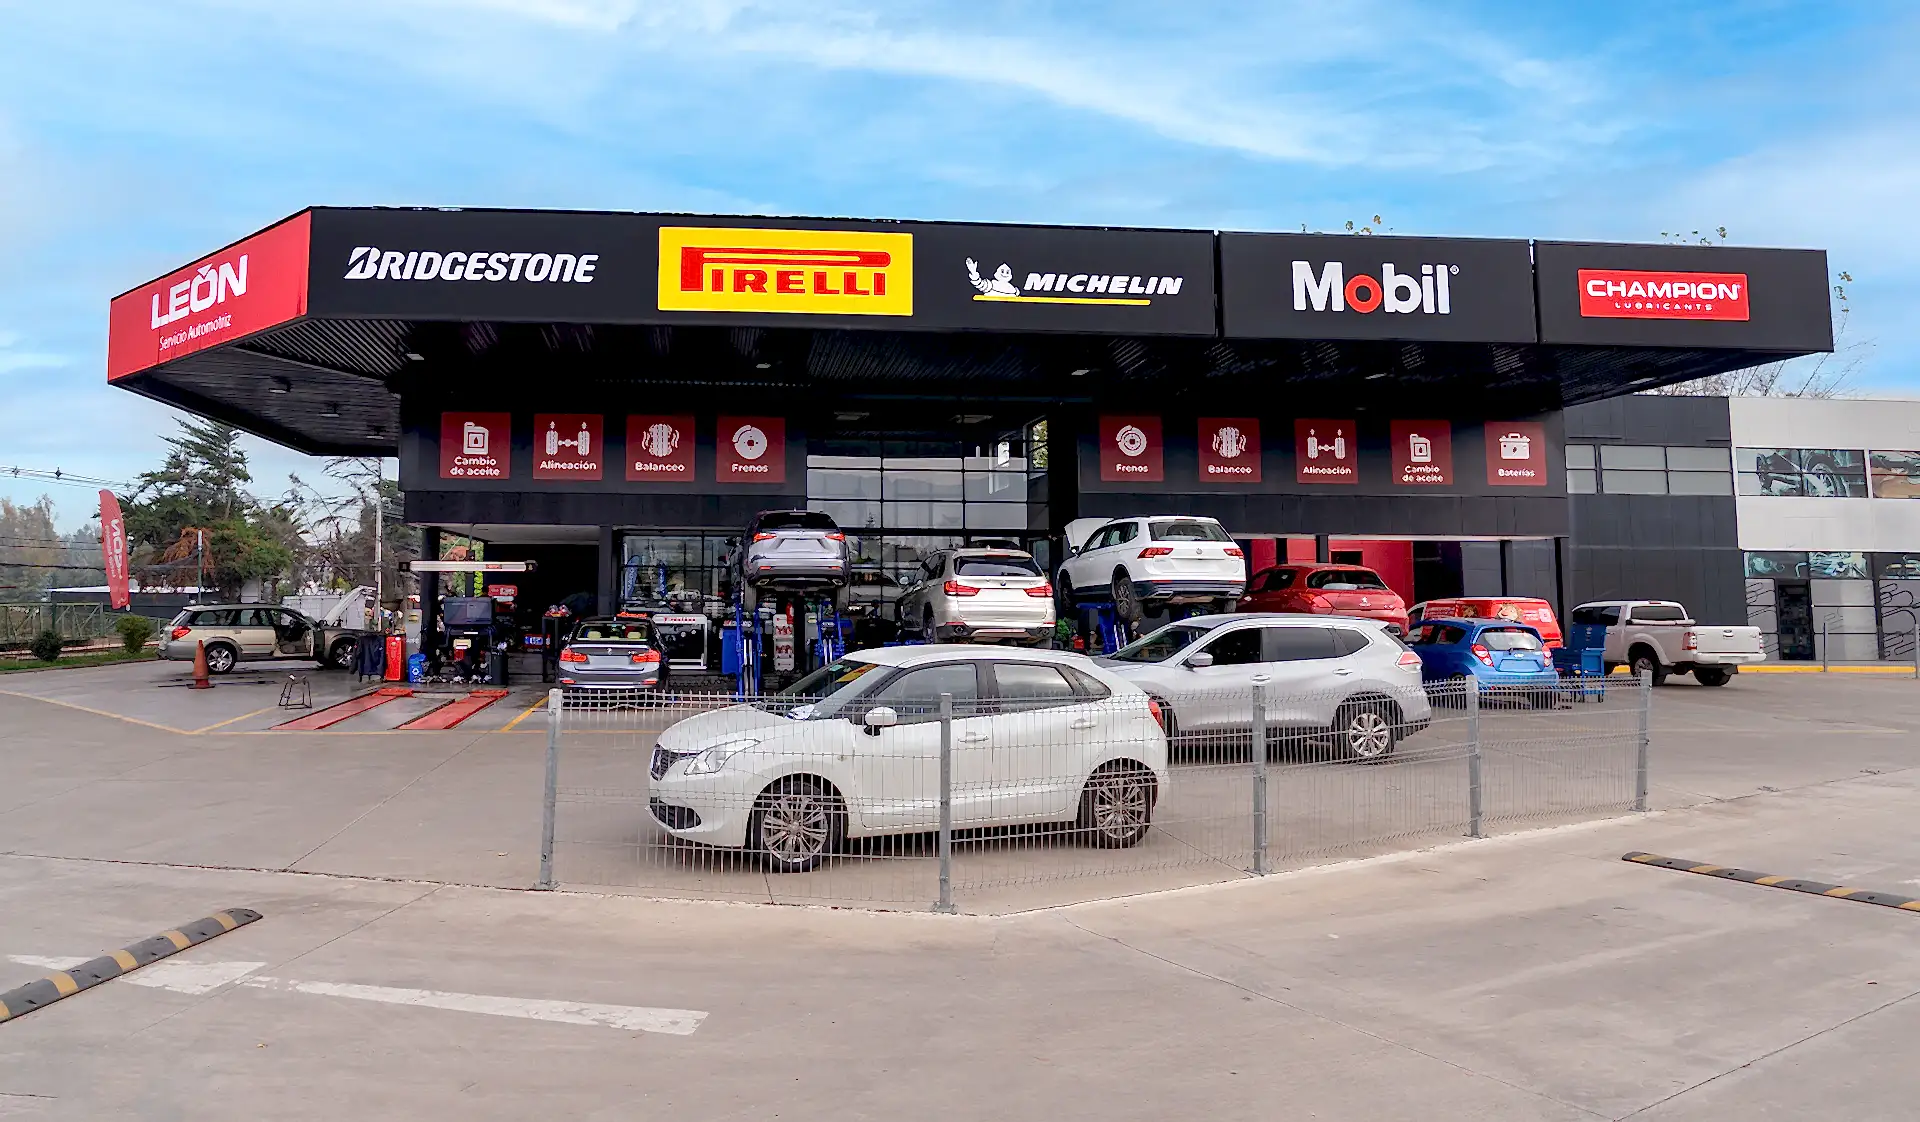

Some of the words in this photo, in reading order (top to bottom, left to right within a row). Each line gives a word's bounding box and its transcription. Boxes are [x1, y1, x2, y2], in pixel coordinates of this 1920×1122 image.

[343, 246, 600, 283] BRIDGESTONE
[681, 247, 891, 296] PIRELLI
[1023, 272, 1183, 296] MICHELIN
[1587, 280, 1740, 300] CHAMPION
[1615, 302, 1713, 311] LUBRICANTS
[159, 329, 187, 351] Servicio
[188, 312, 232, 340] Automotriz
[454, 456, 497, 466] Cambio
[540, 460, 597, 470] Alineación
[450, 466, 464, 476] de
[466, 467, 500, 476] aceite
[635, 462, 685, 472] Balanceo
[731, 464, 768, 473] Frenos
[1116, 464, 1149, 473] Frenos
[1208, 465, 1252, 474] Balanceo
[1303, 465, 1352, 475] Alineación
[1404, 465, 1440, 474] Cambio
[1498, 468, 1535, 477] Baterías
[1402, 474, 1414, 482] de
[1416, 474, 1444, 483] aceite
